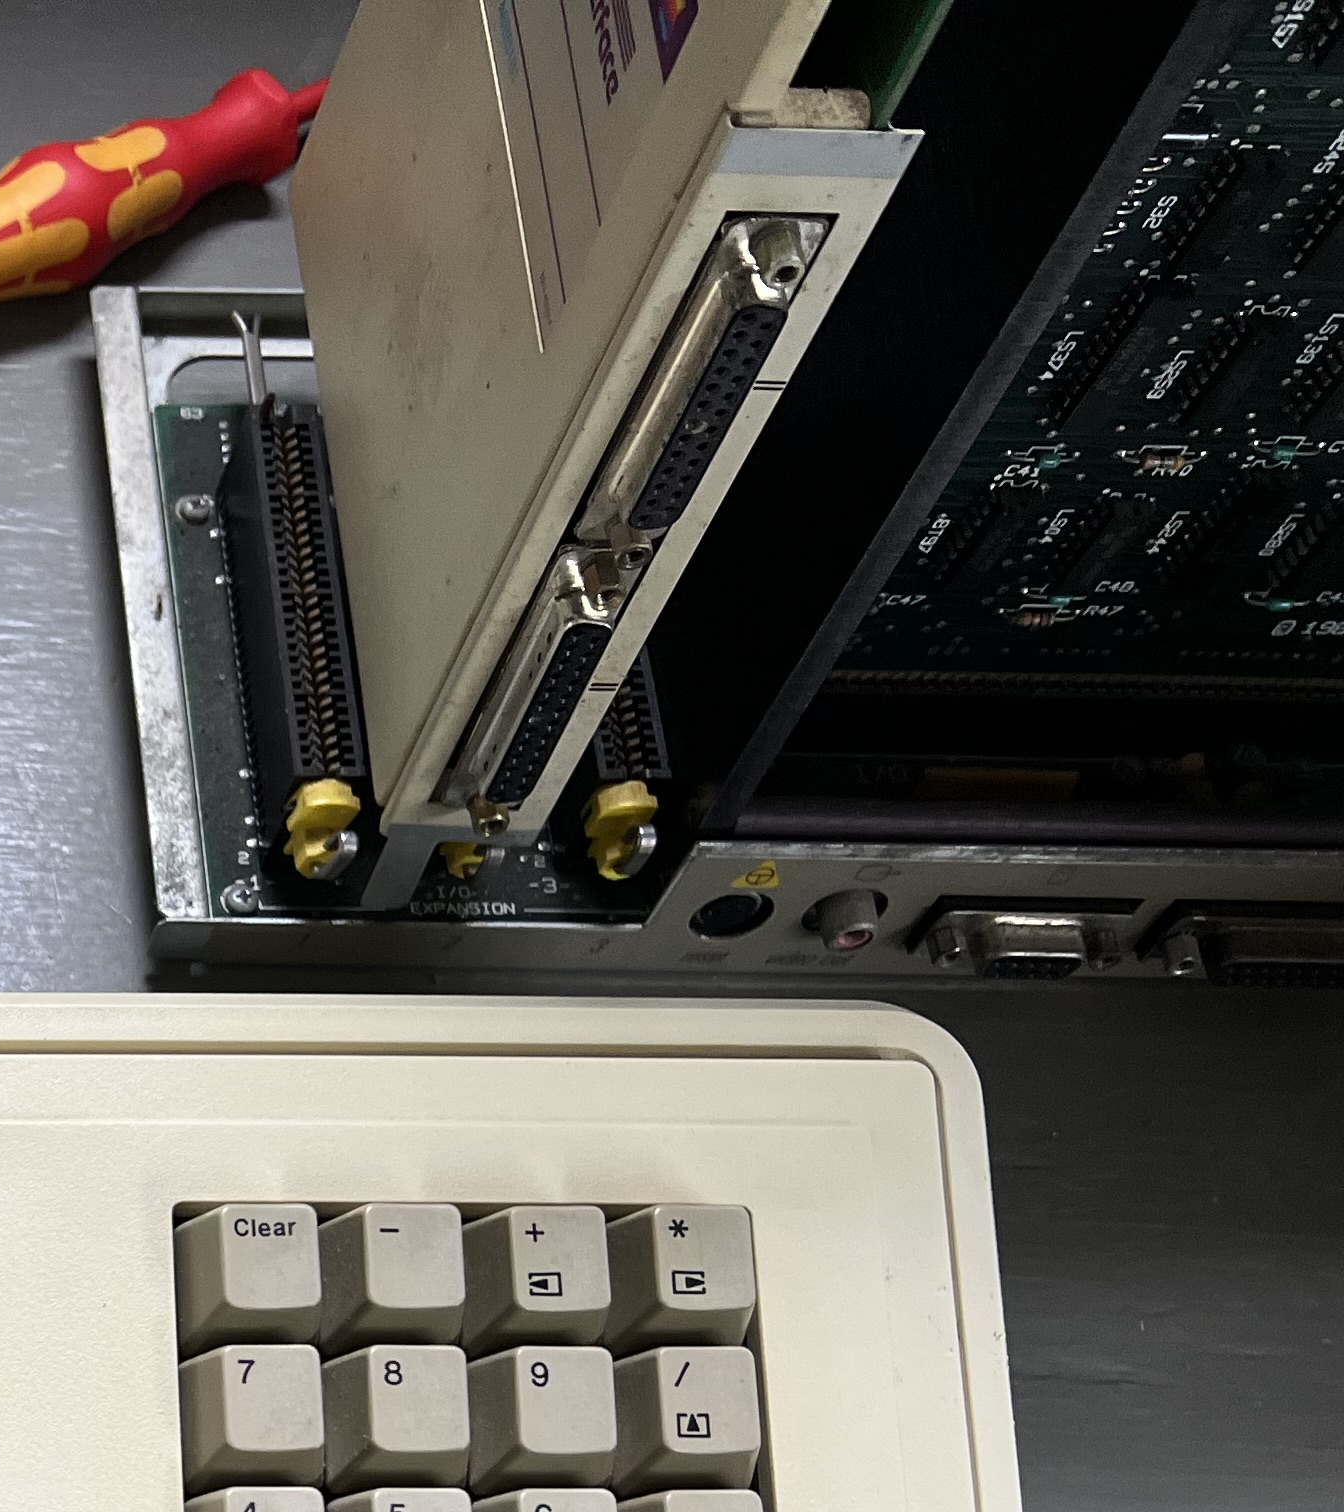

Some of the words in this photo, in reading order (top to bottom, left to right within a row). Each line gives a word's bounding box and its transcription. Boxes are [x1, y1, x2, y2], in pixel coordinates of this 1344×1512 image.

[1142, 195, 1178, 229] S32
[237, 850, 250, 866] 2
[409, 901, 517, 917] EXPANSION
[233, 1218, 297, 1237] Clear
[237, 1359, 256, 1385] 7
[383, 1360, 403, 1386] 8
[530, 1361, 549, 1388] 9
